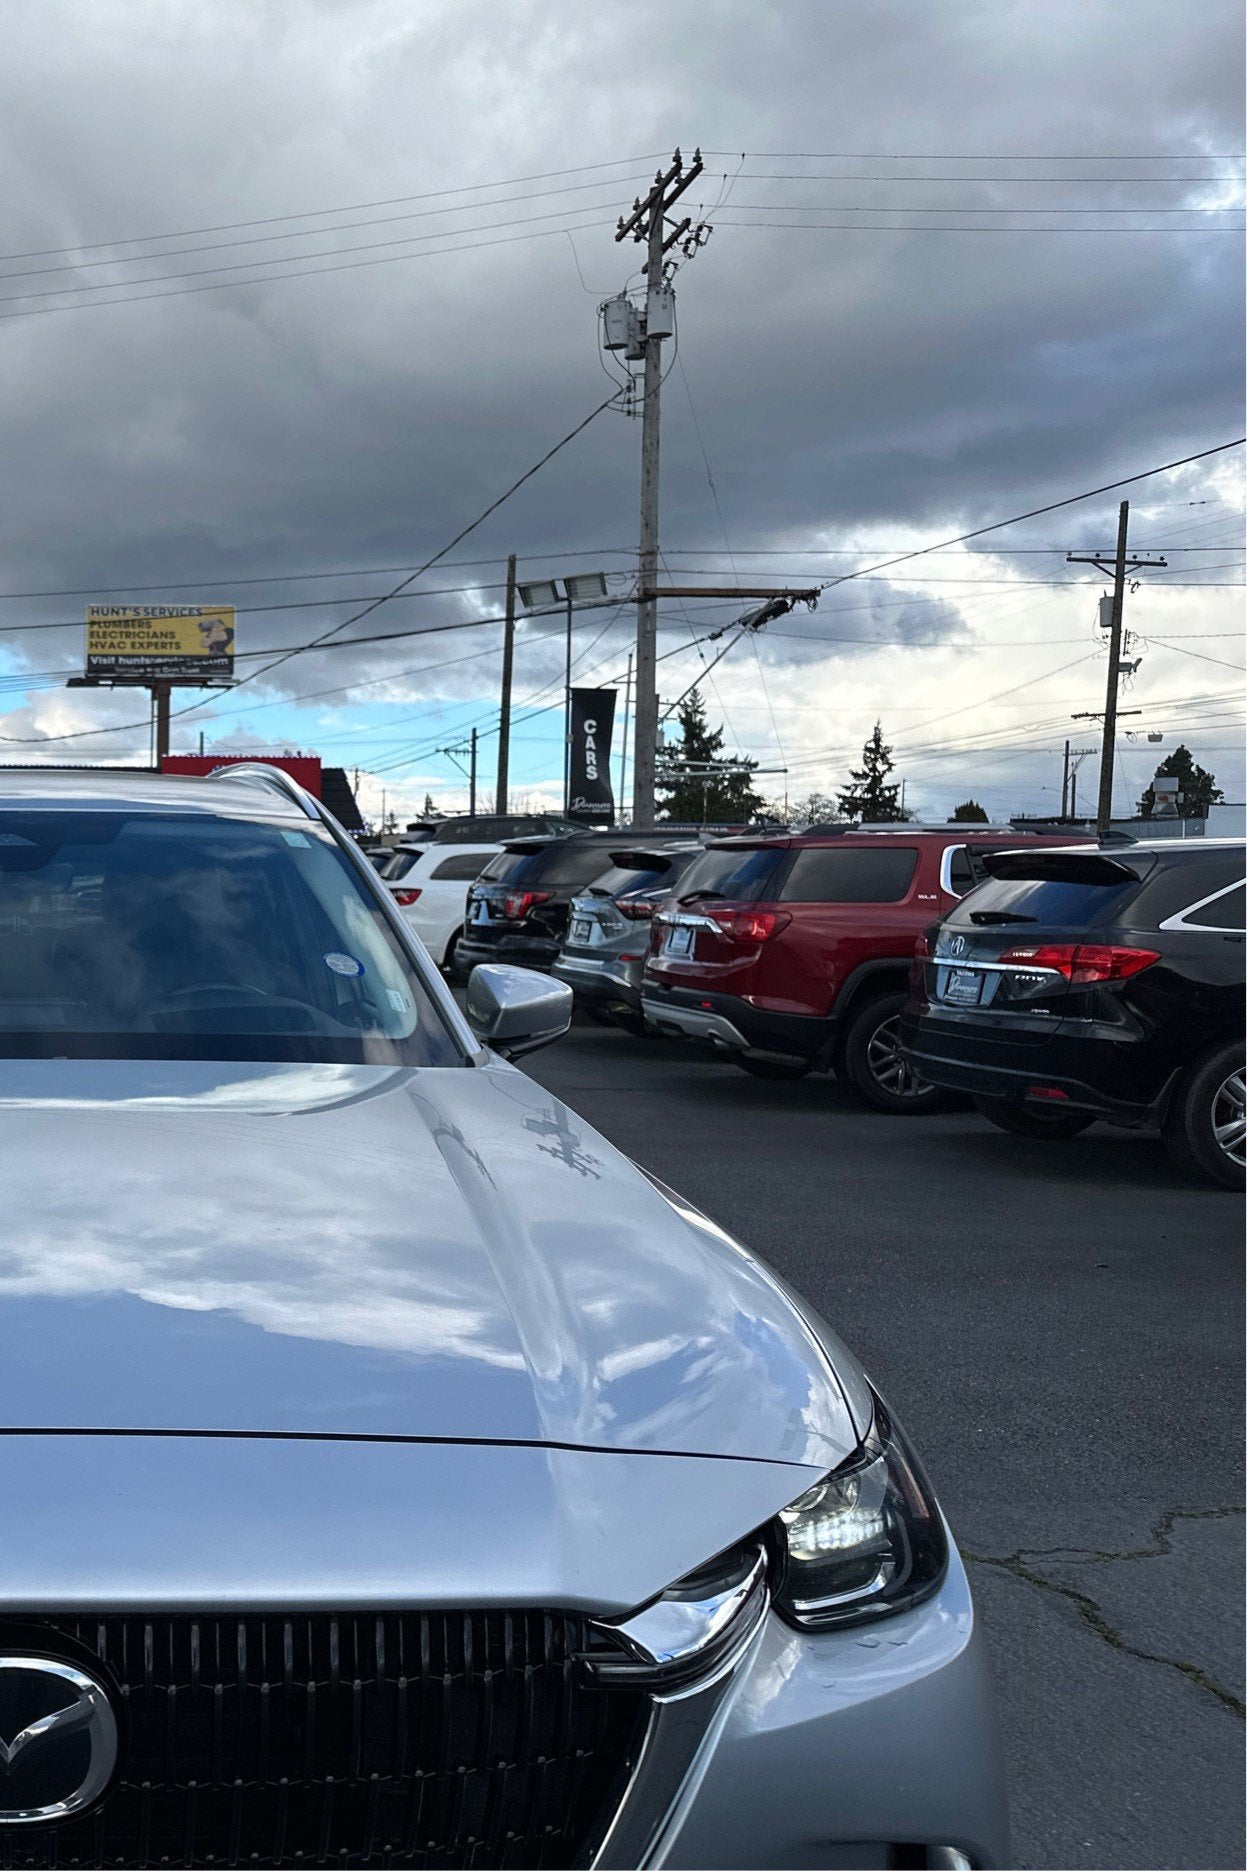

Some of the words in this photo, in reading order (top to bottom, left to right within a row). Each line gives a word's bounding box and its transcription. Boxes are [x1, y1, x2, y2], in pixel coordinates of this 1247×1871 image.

[91, 606, 140, 617] HUNT'S
[143, 607, 203, 617] SERVICES
[89, 620, 152, 629] PLUMBERS
[89, 630, 176, 640] ELECTRICIANS
[89, 641, 127, 650] HVAC
[131, 641, 182, 650] EXPERTS
[89, 655, 115, 665] Visit
[583, 718, 598, 781] CARS
